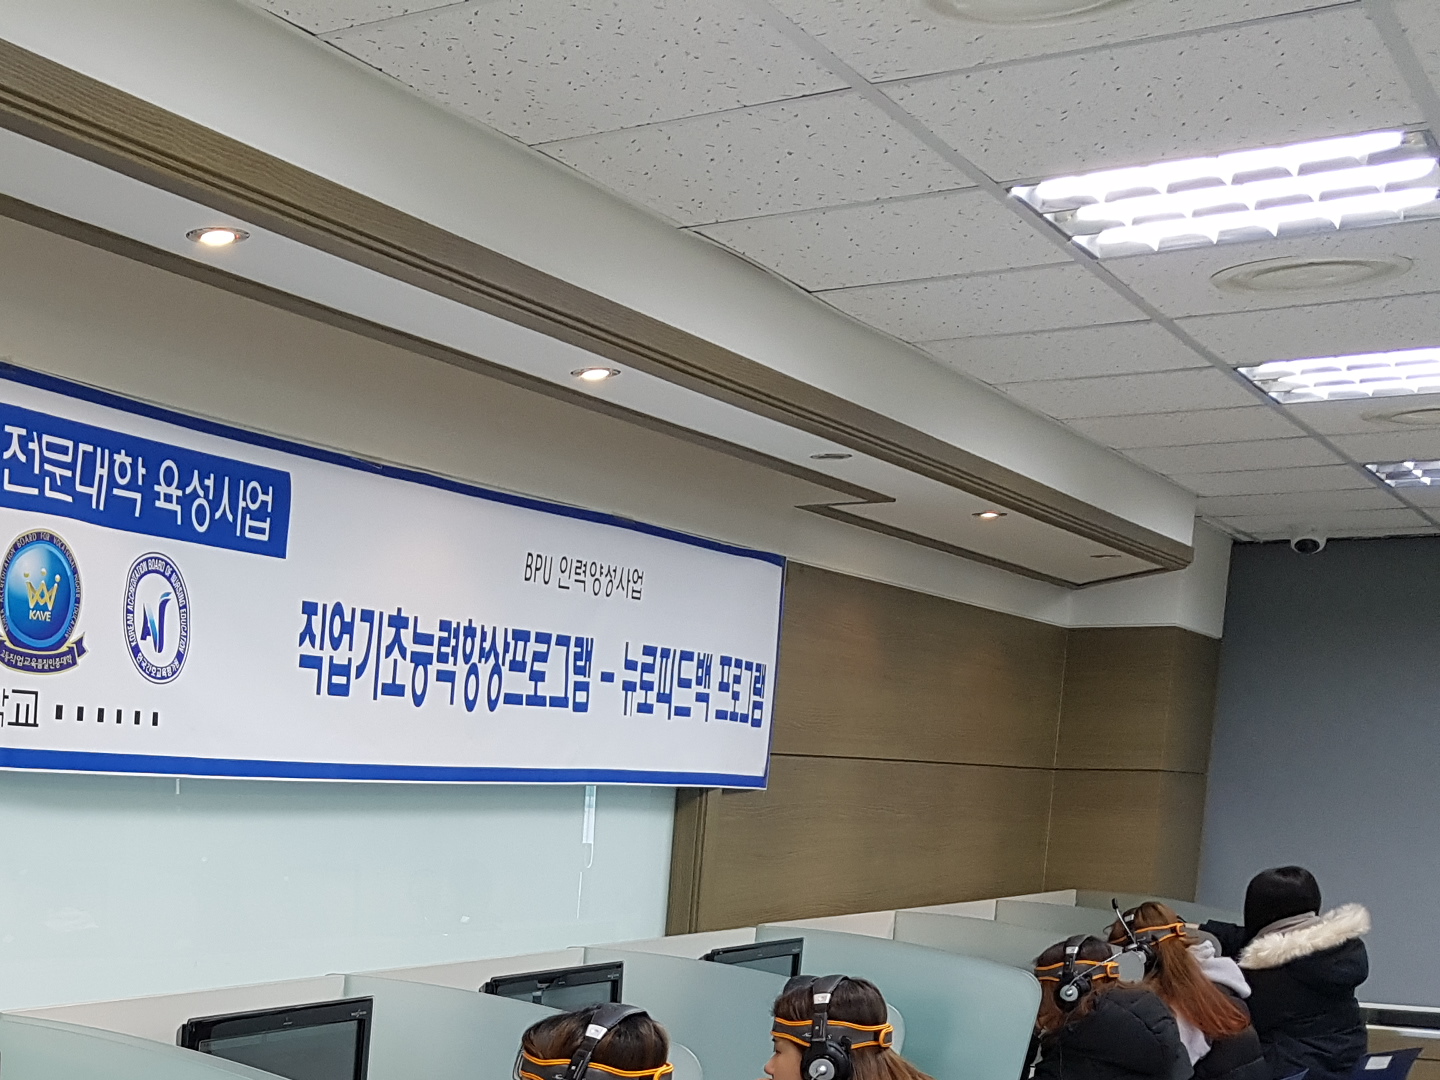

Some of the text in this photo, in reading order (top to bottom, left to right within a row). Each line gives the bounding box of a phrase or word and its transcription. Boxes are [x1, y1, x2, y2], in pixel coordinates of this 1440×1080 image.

[3, 423, 146, 518] 전문대학
[154, 459, 274, 543] 육성사업
[17, 533, 38, 549] BOARD
[524, 551, 645, 602] BPU 인력양성사업
[29, 609, 52, 622] KAVE
[126, 613, 137, 648] KOREAN
[178, 608, 188, 655] EDUCATION
[298, 600, 595, 713] 직업기초능력향상프로그램
[621, 641, 712, 722] 뉴로피드백
[715, 654, 768, 729] 프로그램
